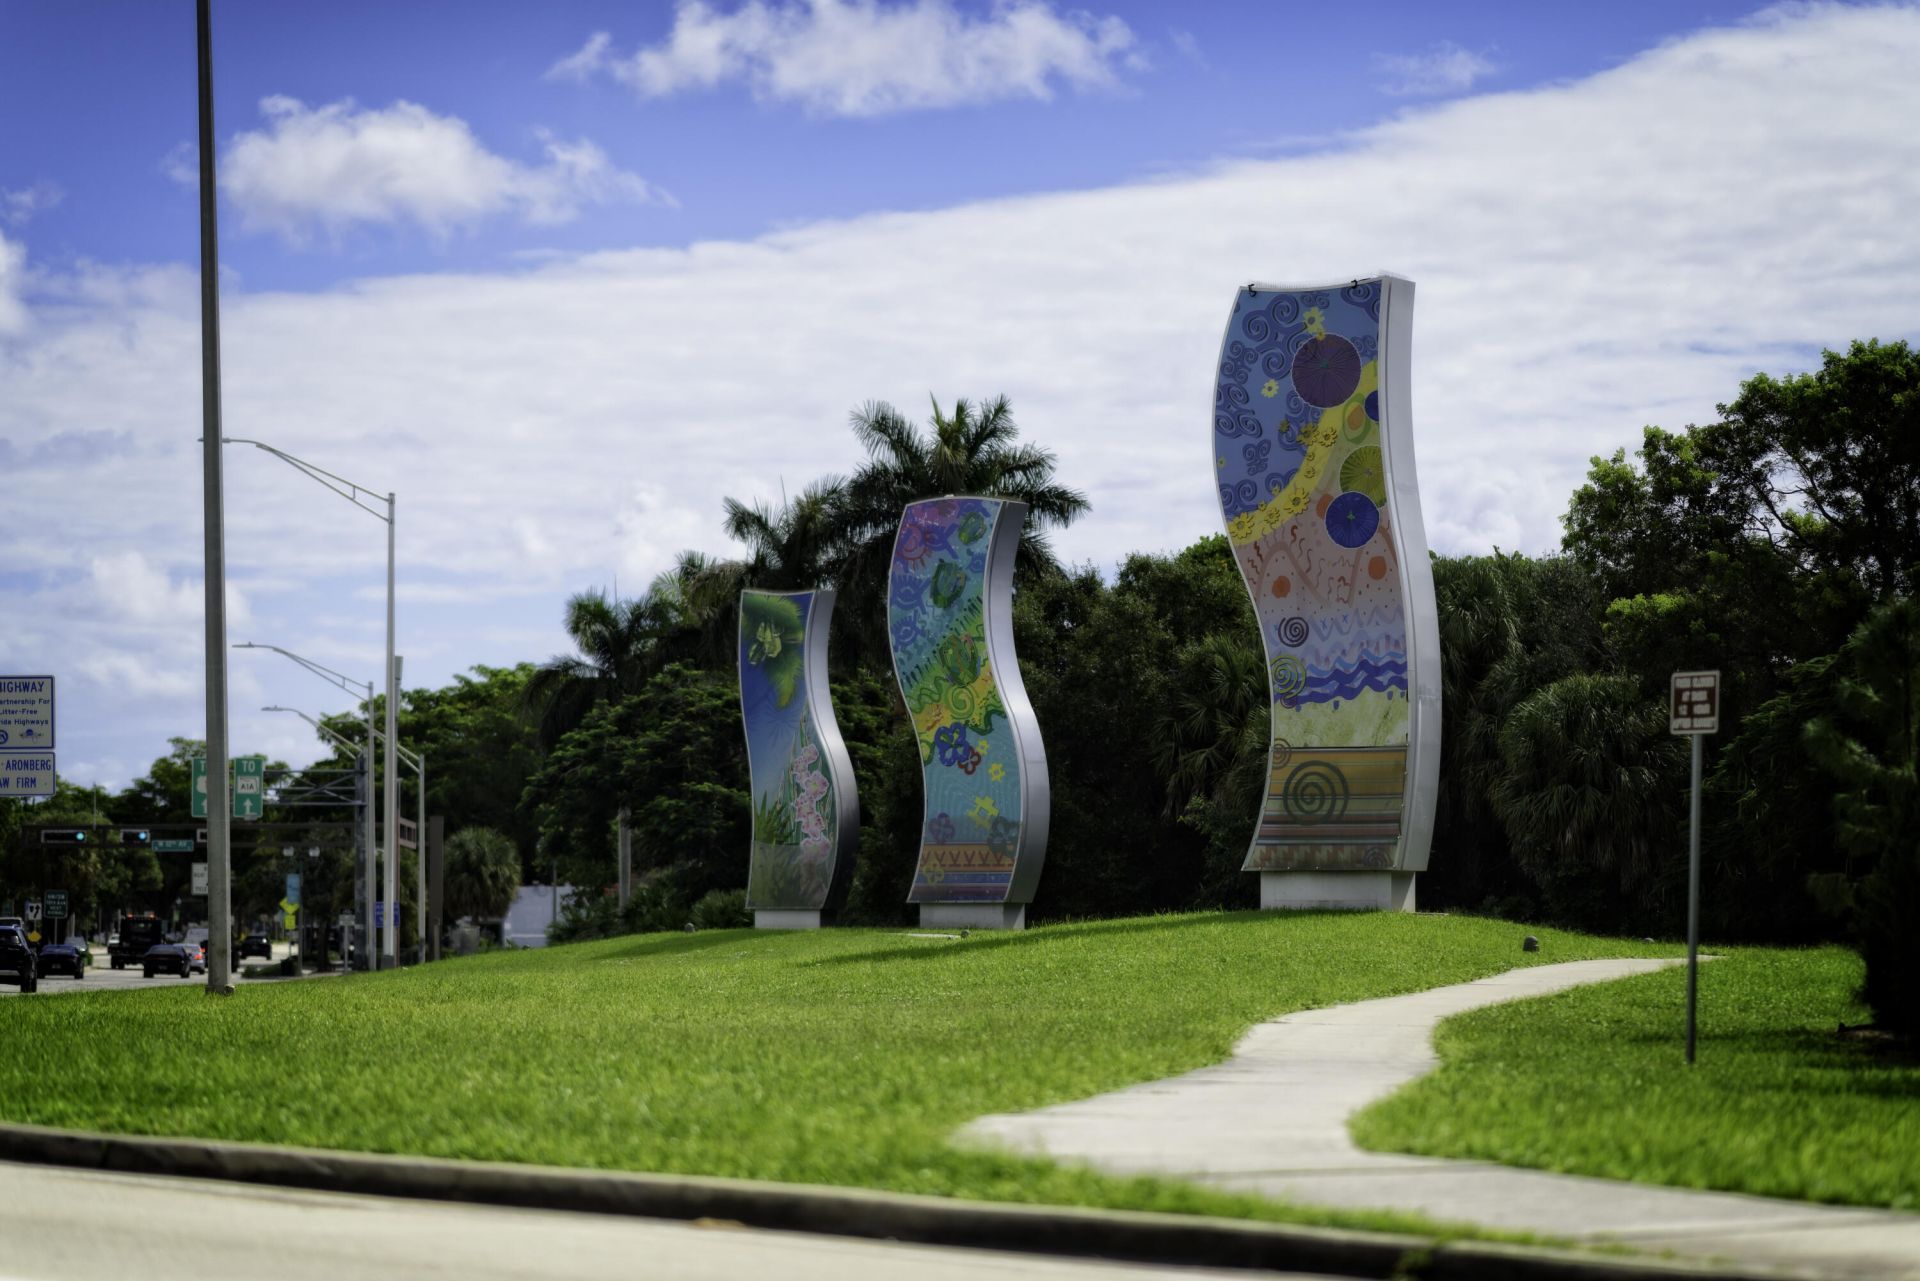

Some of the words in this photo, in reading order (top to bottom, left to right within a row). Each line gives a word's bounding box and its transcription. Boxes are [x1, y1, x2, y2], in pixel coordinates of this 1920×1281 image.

[5, 759, 52, 771] ARONBERG
[242, 761, 255, 772] TO
[16, 777, 37, 789] FIRM
